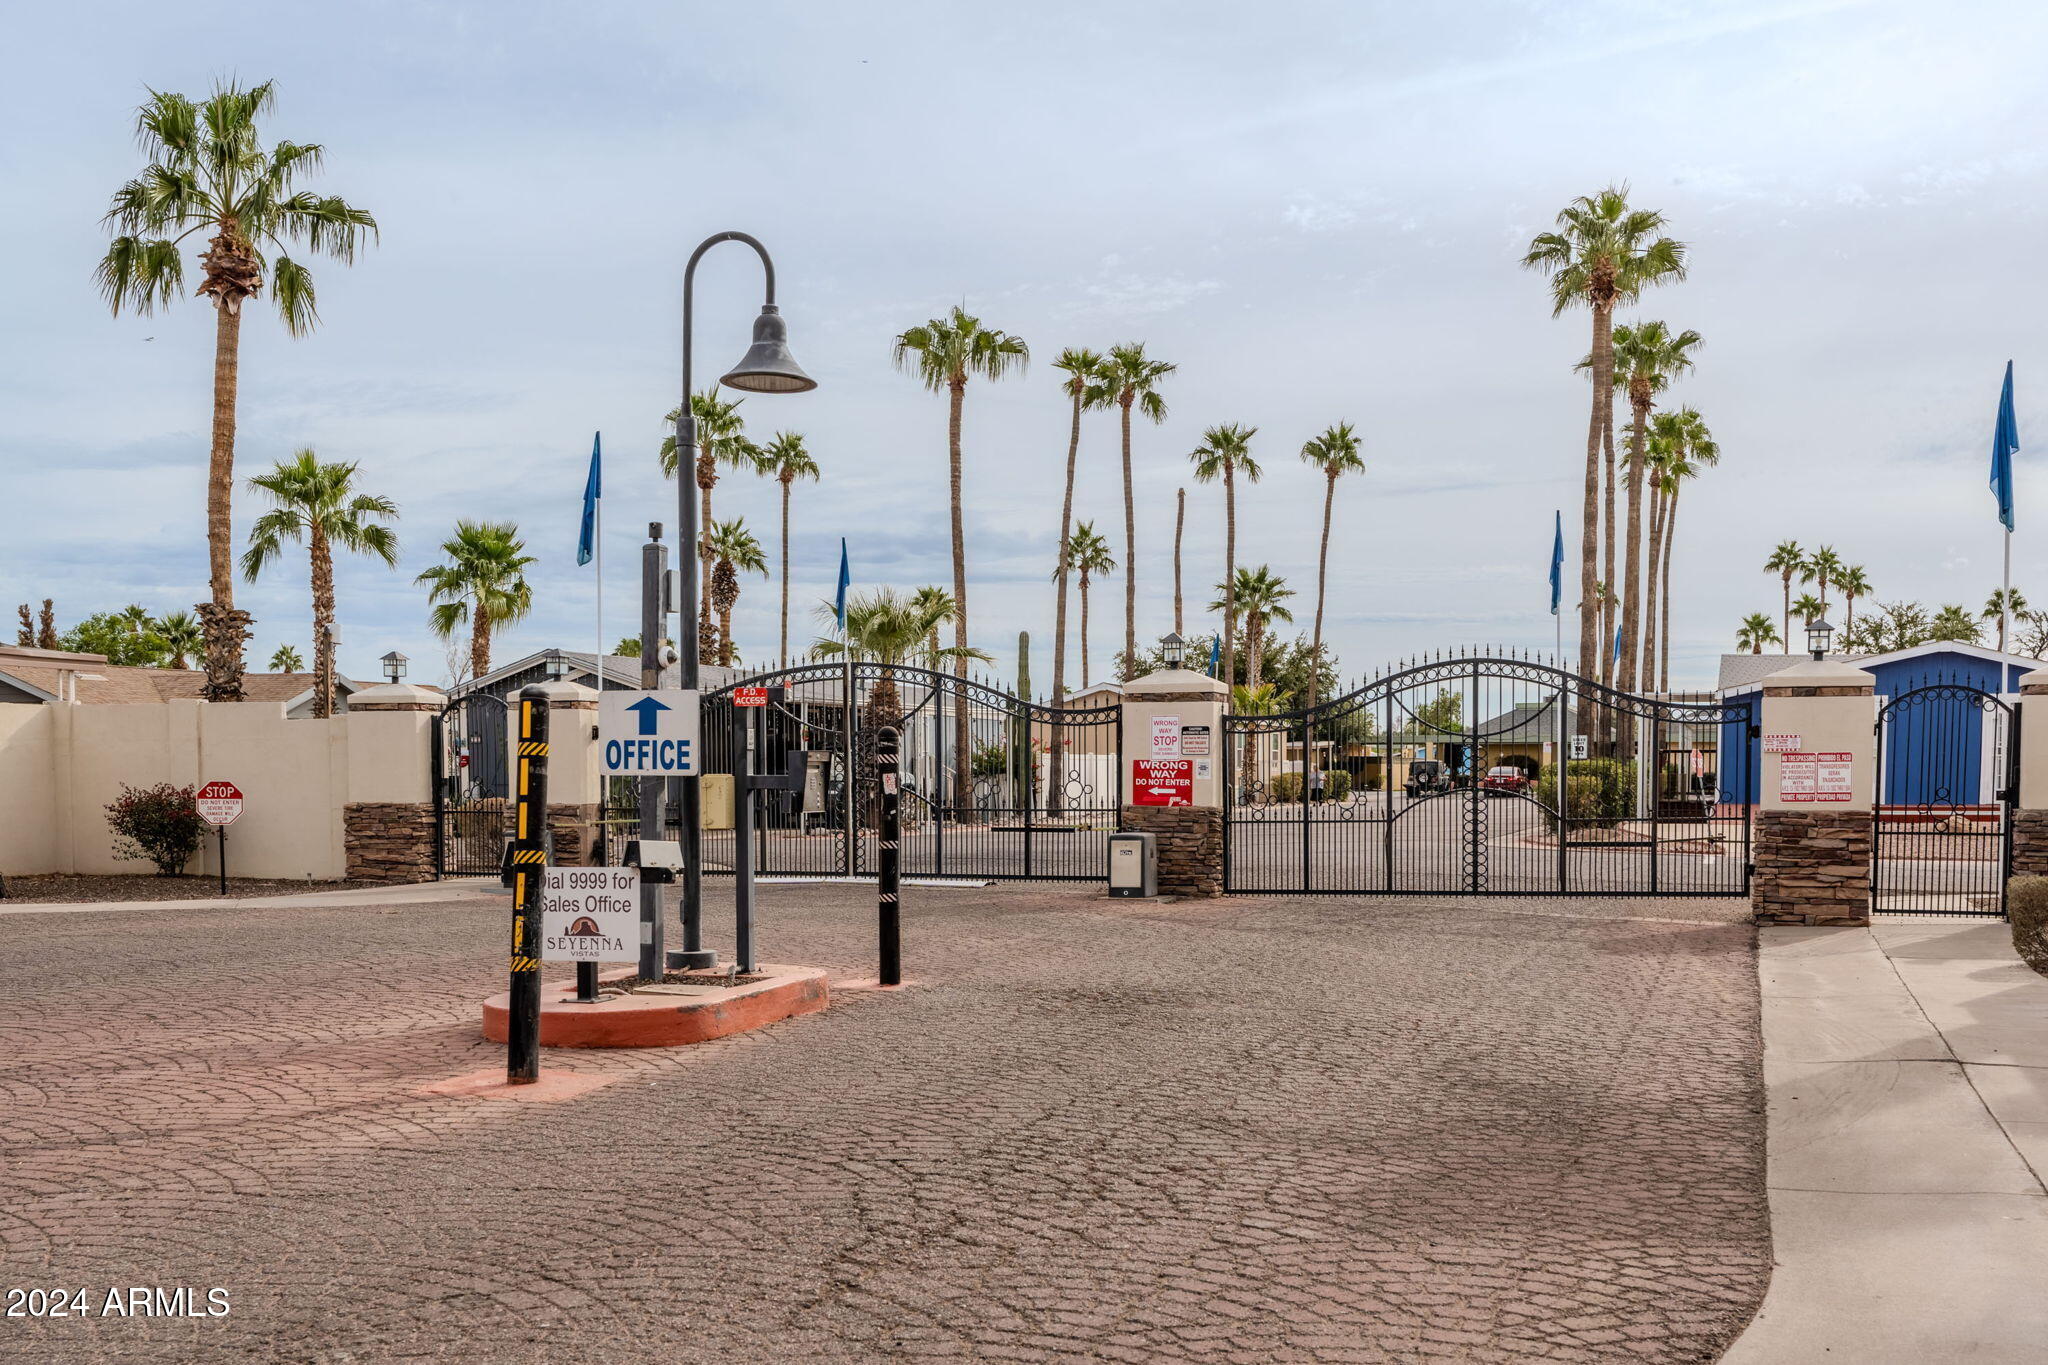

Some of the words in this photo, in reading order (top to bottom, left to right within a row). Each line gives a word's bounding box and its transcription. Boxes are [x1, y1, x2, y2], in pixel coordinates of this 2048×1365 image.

[1154, 736, 1178, 746] STOP
[606, 740, 690, 770] OFFICE
[1140, 761, 1188, 769] WRONG
[1150, 770, 1177, 778] WAY
[206, 786, 234, 798] STOP
[570, 872, 607, 889] 9999
[612, 872, 634, 889] for
[585, 895, 632, 912] Office
[547, 937, 623, 950] SEYENNA
